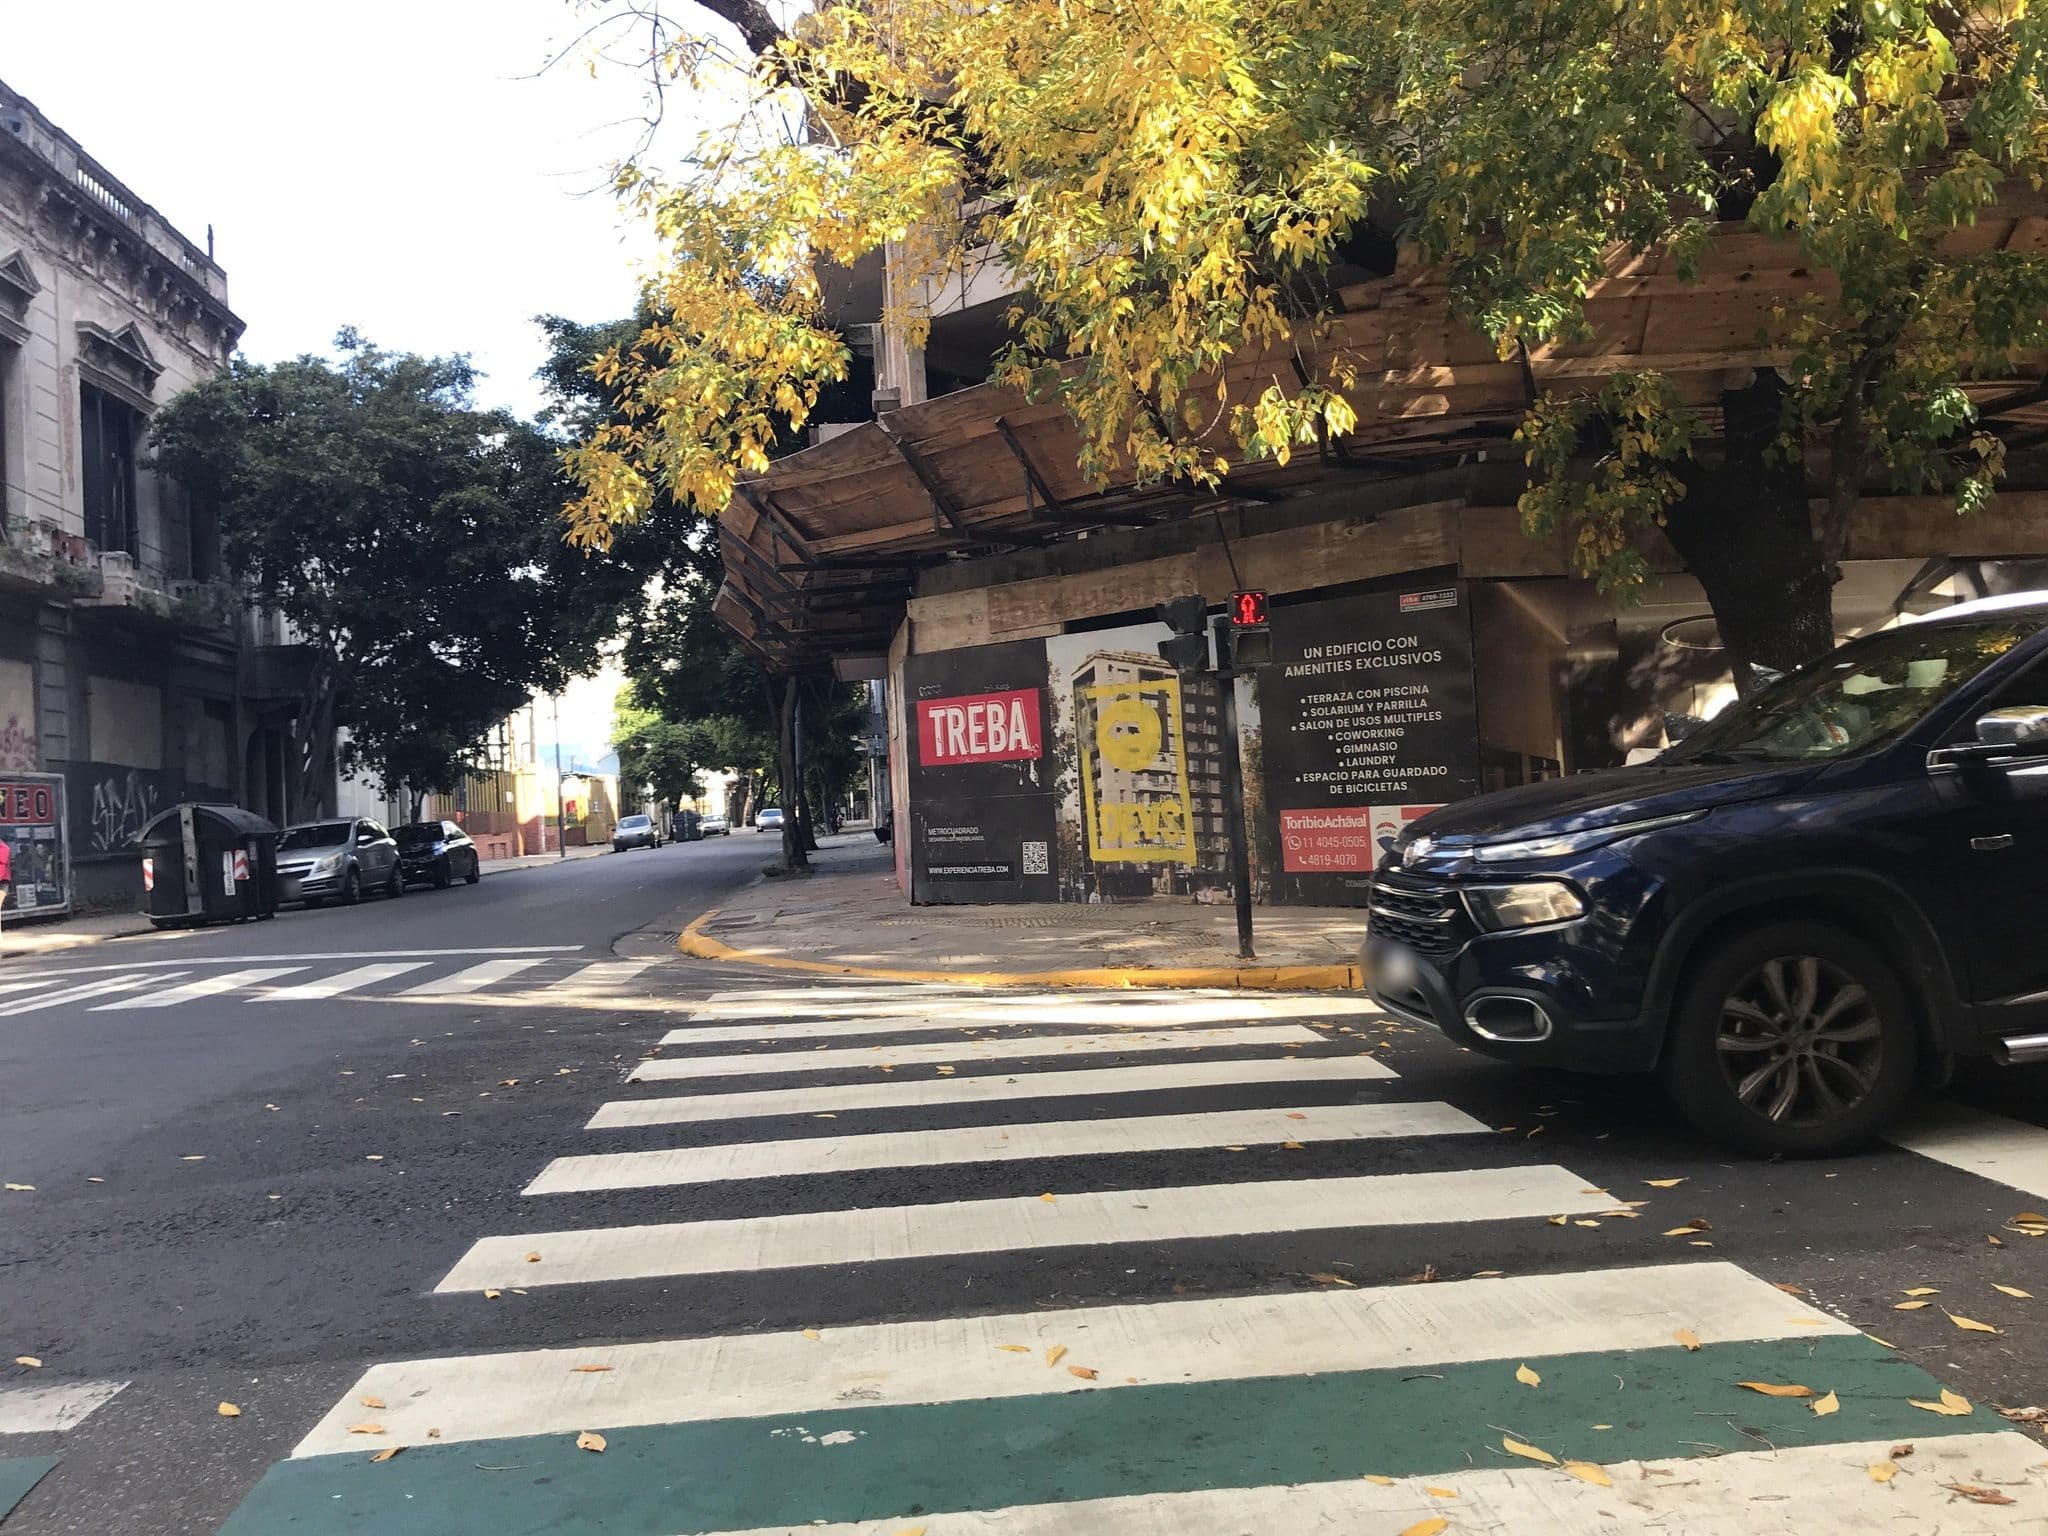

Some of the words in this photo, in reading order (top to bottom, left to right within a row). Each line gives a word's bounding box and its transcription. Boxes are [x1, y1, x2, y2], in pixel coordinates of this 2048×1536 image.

[1304, 647, 1322, 659] UN
[1326, 640, 1382, 656] EDIFICIO
[1386, 636, 1418, 650] CON
[1285, 660, 1352, 677] AMENITIES
[1357, 651, 1442, 669] EXCLUSIVOS
[1307, 692, 1353, 704] TERRAZA
[1357, 689, 1380, 699] CON
[1384, 685, 1429, 696] PISCINA
[1311, 704, 1364, 717] SOLARIUM
[1367, 702, 1373, 711] Y
[1377, 699, 1427, 711] PARRILLA
[928, 698, 1030, 757] TREBA
[1299, 720, 1333, 731] SALON
[1336, 718, 1349, 728] DE
[1352, 716, 1381, 726] USOS
[1384, 711, 1442, 723] MULTIPLES
[1336, 728, 1404, 741] COWORKING
[1343, 742, 1398, 754] GIMNASIO
[1346, 755, 1395, 767] LAUNDRY
[1303, 771, 1348, 782] ESPACIO
[1352, 769, 1379, 780] PARA
[1383, 766, 1447, 777] GUARDADO
[1330, 785, 1343, 794] DE
[1346, 781, 1407, 793] BICICLETAS
[1303, 838, 1312, 847] 11
[1309, 854, 1356, 866] 4819-4070
